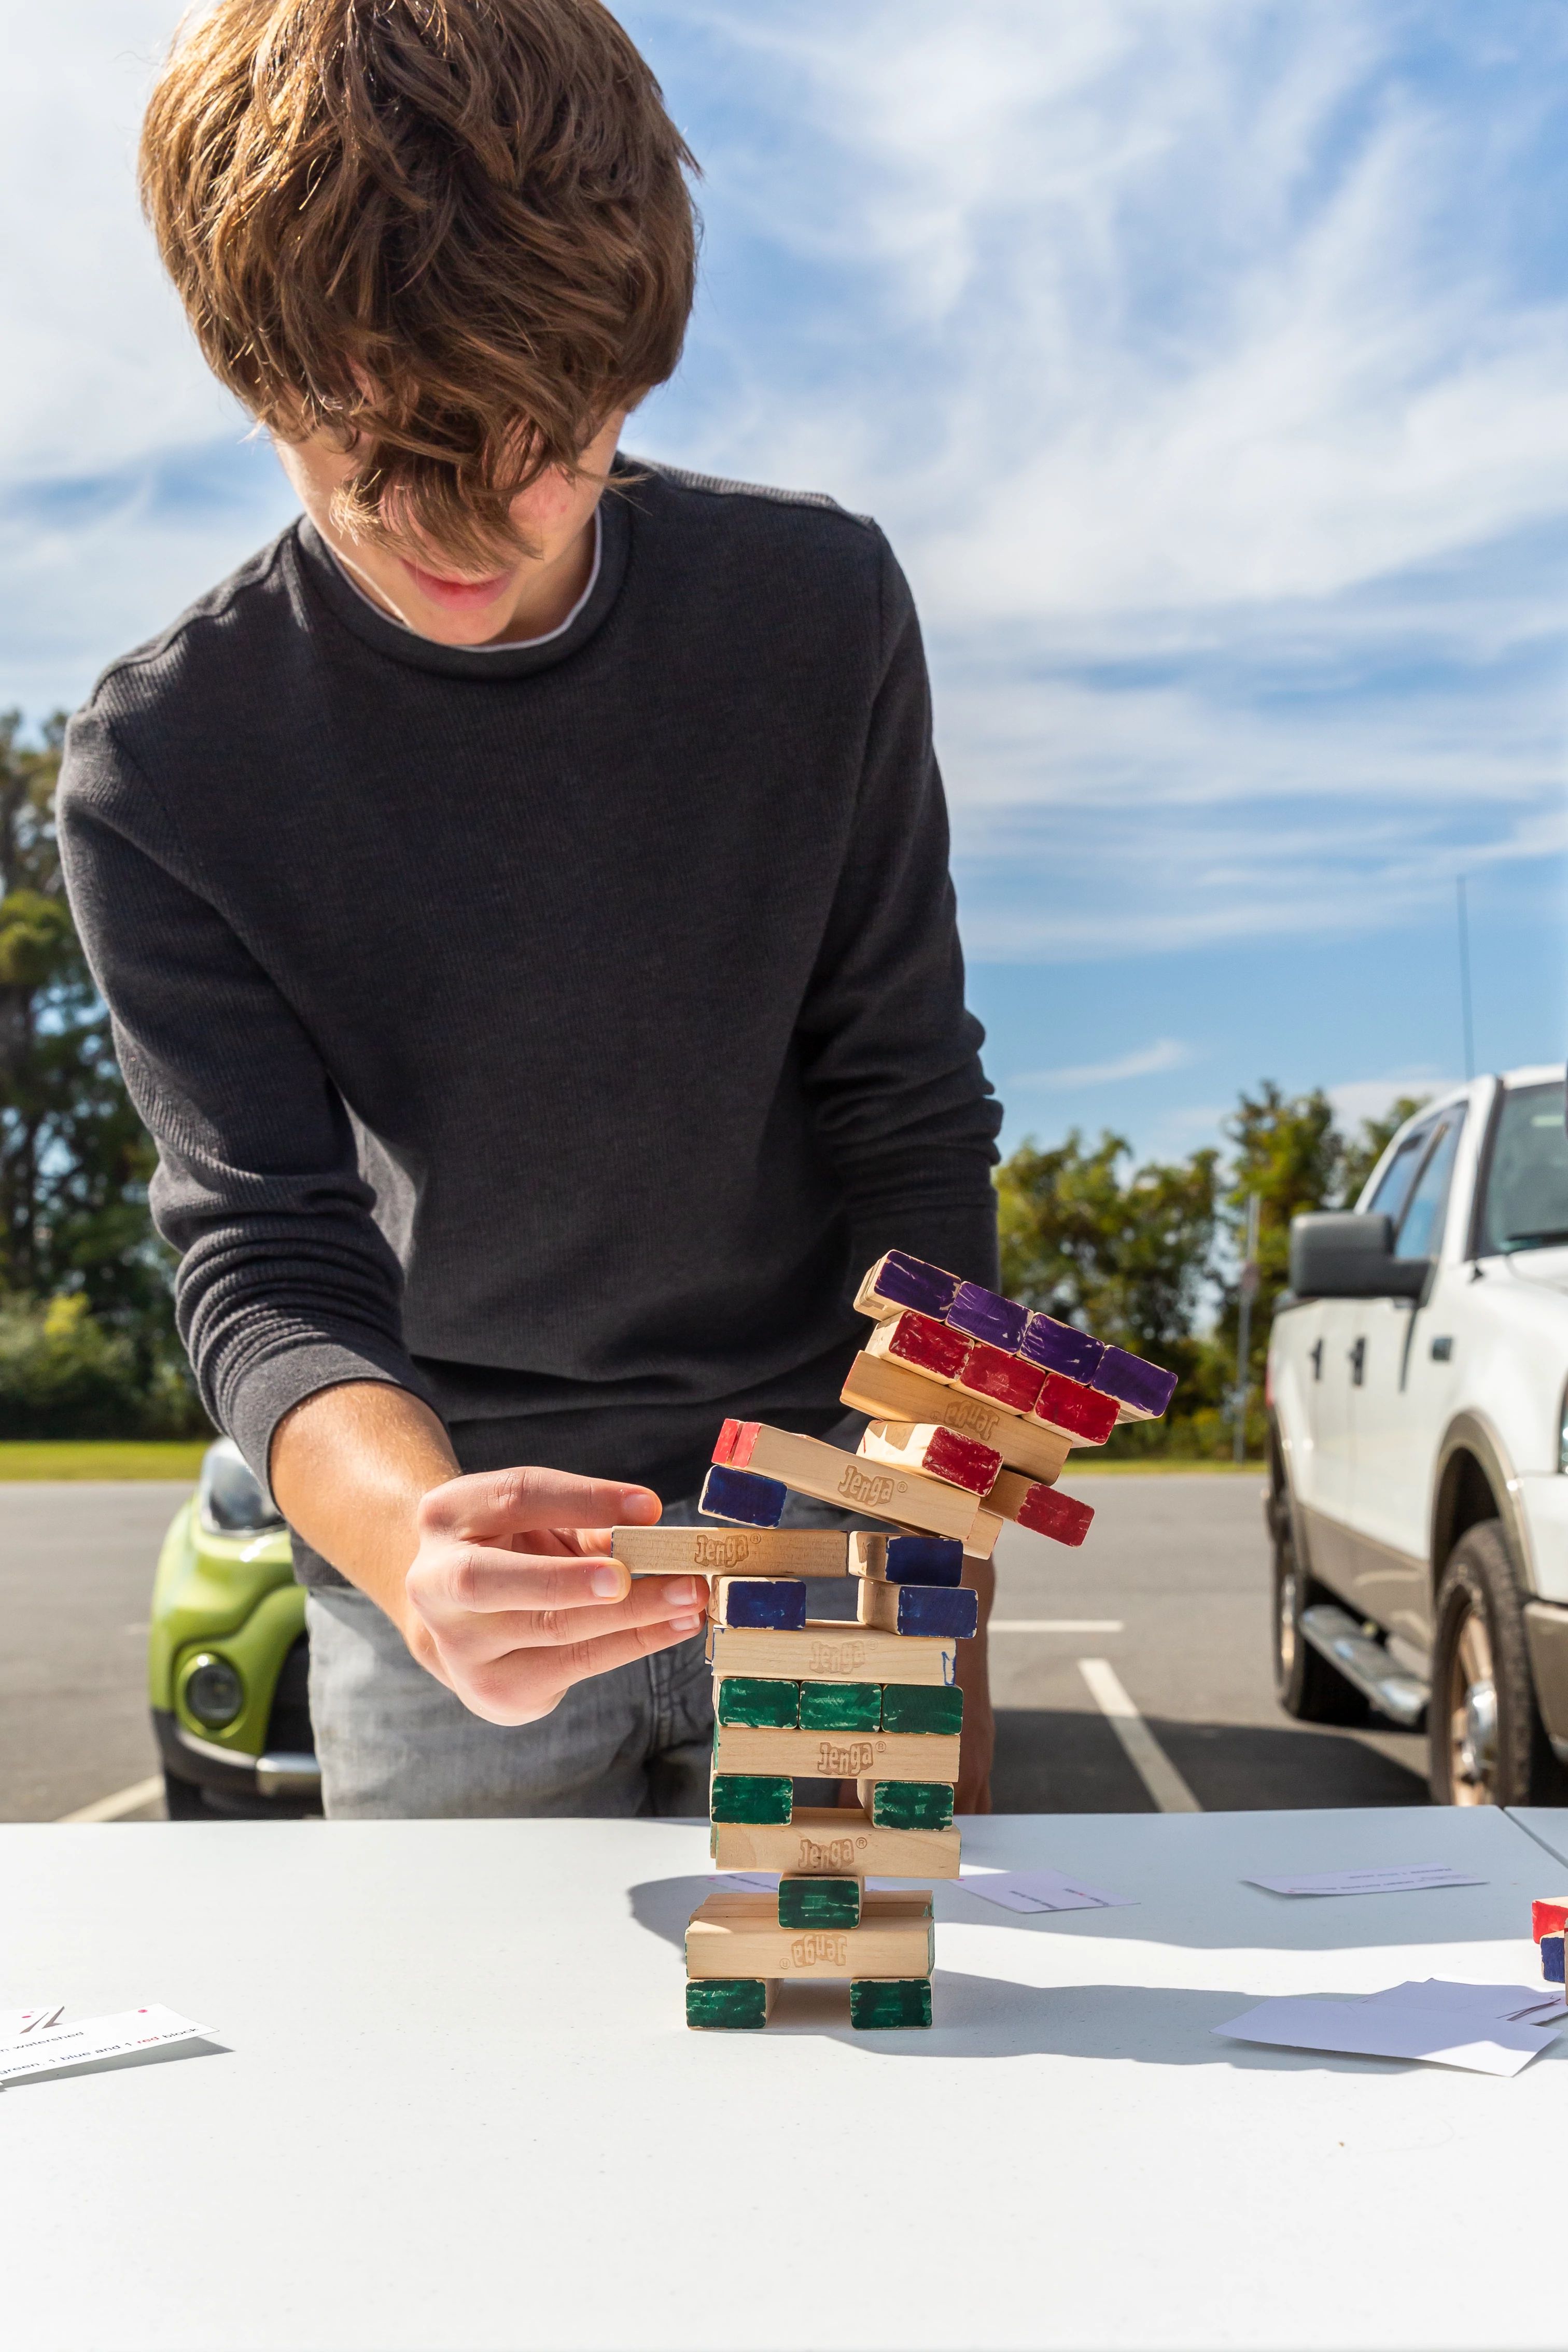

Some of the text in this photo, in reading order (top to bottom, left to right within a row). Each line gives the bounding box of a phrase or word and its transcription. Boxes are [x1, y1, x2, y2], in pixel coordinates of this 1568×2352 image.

[12, 2031, 84, 2049] watershed
[60, 2052, 91, 2061] blue
[95, 2045, 120, 2053] and
[162, 2028, 199, 2038] block
